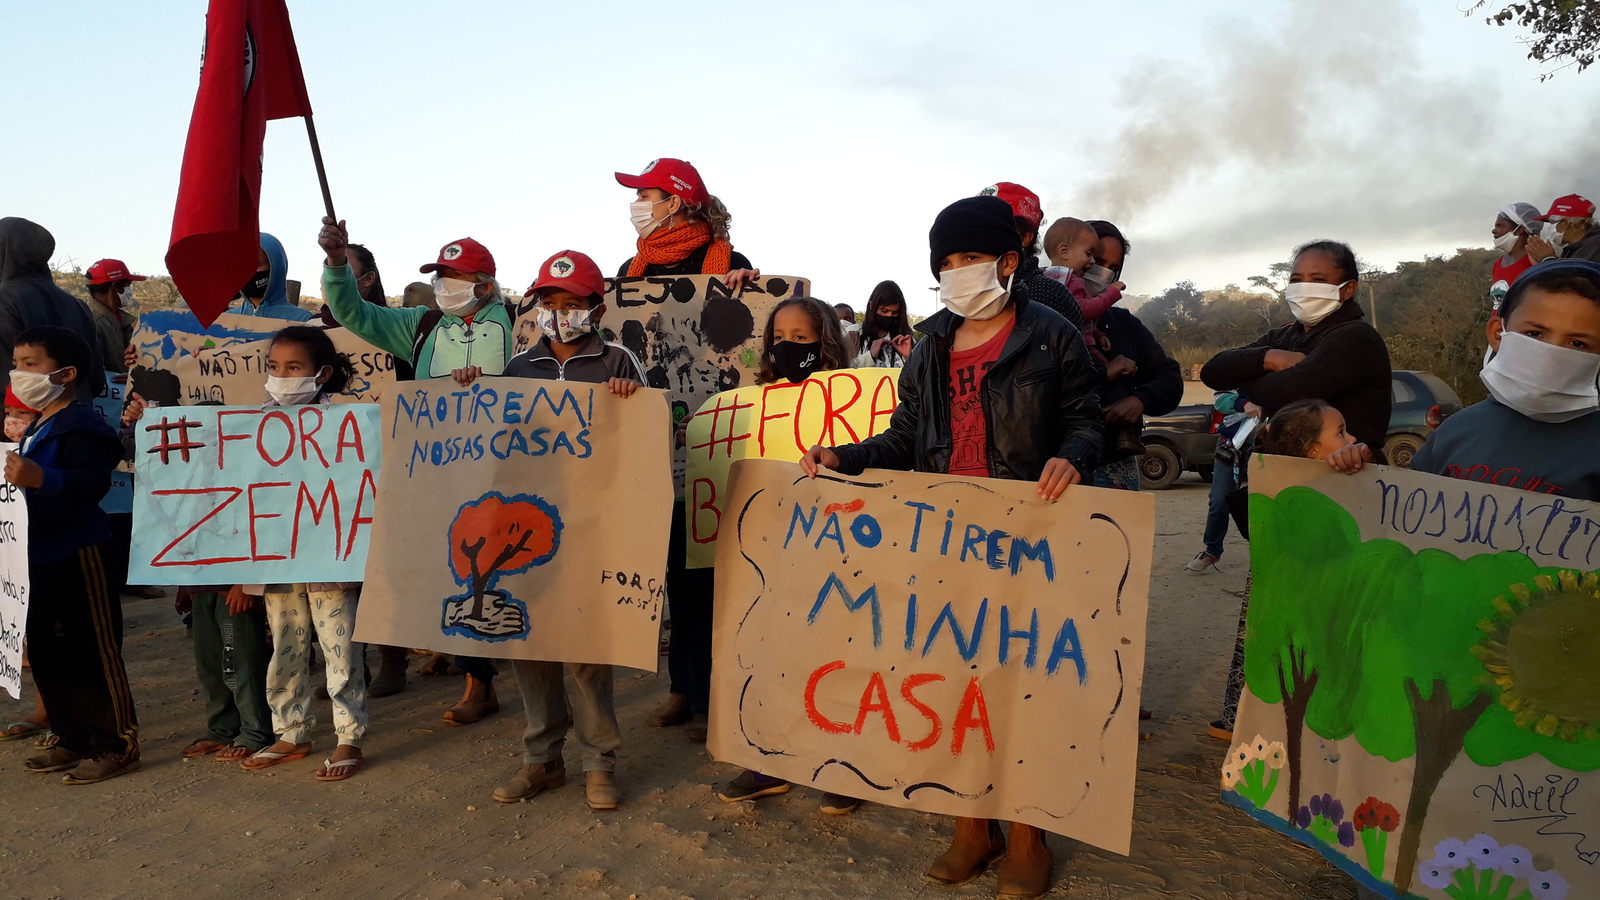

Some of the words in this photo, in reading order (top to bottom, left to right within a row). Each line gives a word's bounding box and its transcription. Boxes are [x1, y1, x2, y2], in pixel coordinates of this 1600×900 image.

[198, 350, 237, 378] NÃO
[392, 388, 447, 439] NÃO
[409, 434, 485, 478] NOSSAS
[489, 427, 592, 459] CASAS
[150, 468, 376, 566] ZEMA
[783, 498, 882, 554] NÃO
[601, 569, 664, 602] FORÇA
[804, 660, 995, 758] CASA
